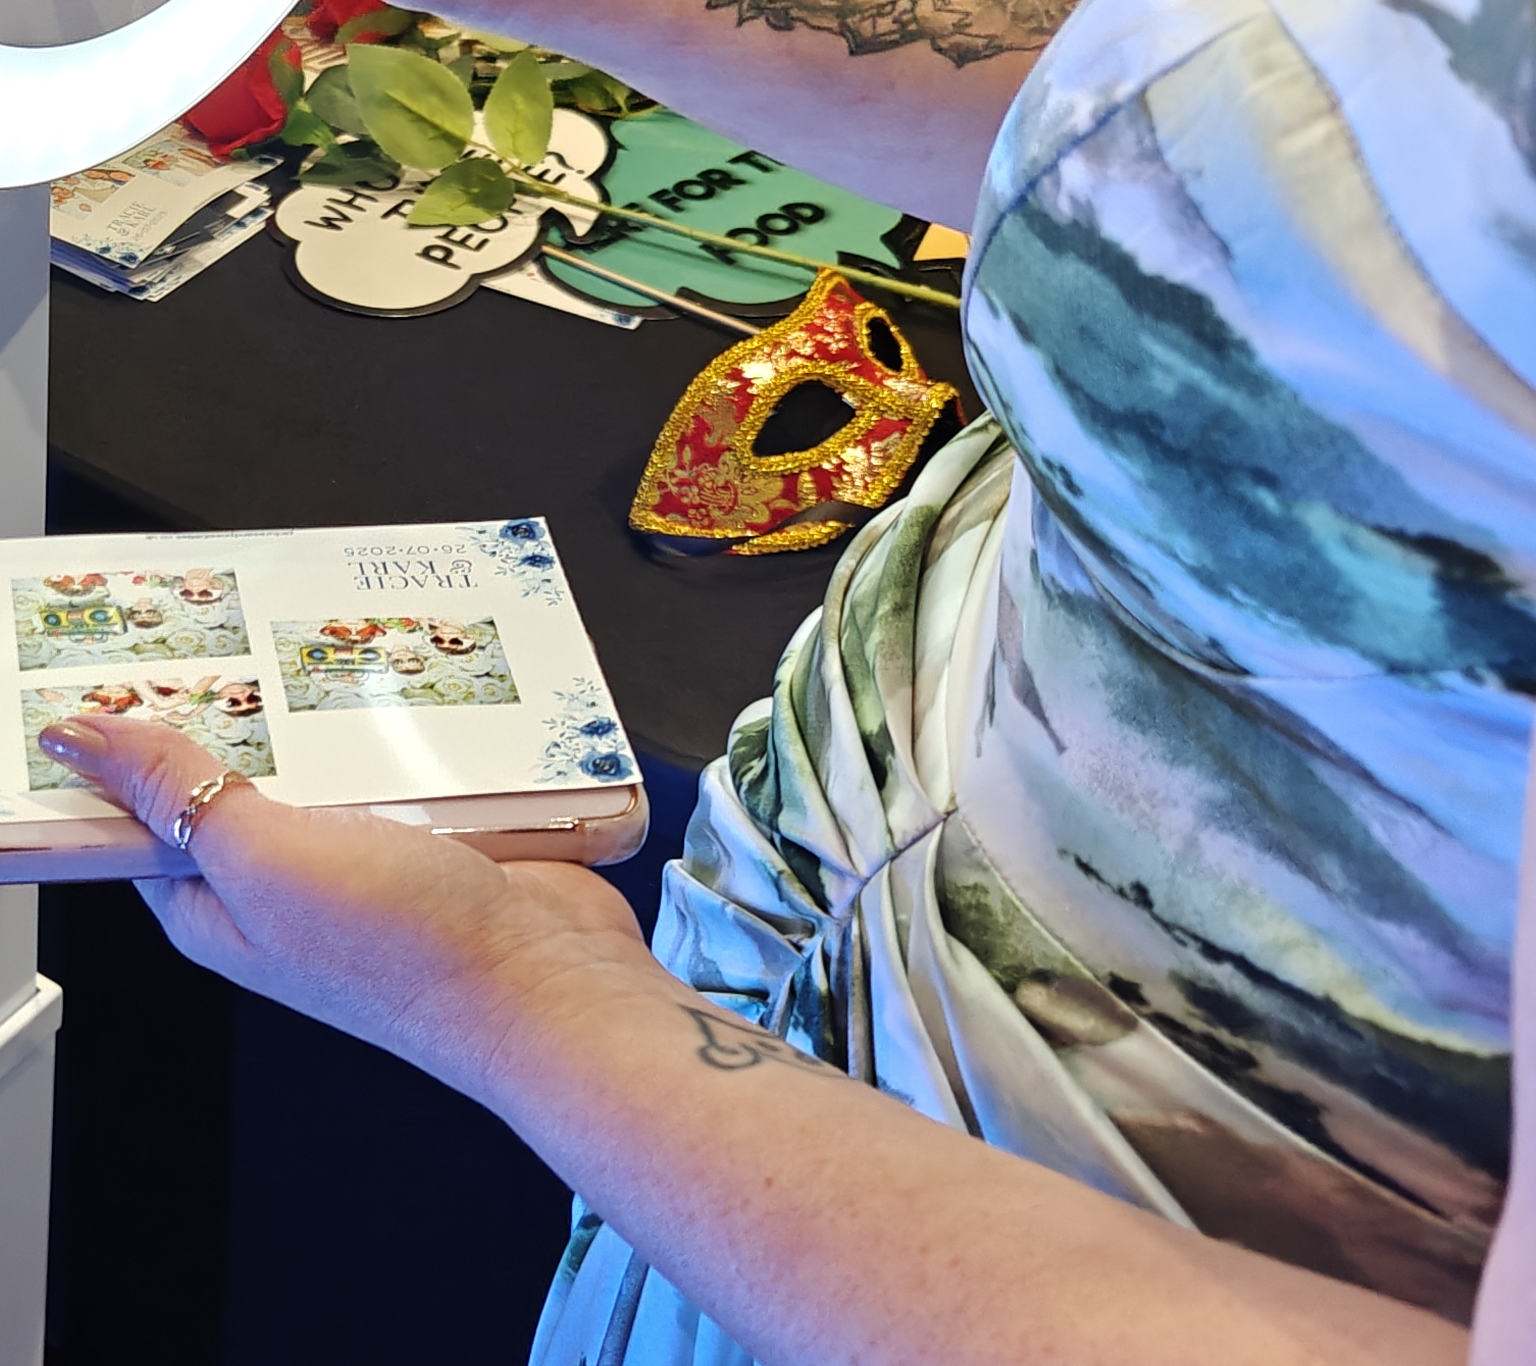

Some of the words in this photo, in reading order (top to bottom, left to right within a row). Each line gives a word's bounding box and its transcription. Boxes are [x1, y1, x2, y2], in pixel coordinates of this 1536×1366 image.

[647, 167, 748, 213] FOR
[347, 561, 436, 576] KARL
[449, 559, 473, 575] &
[353, 573, 478, 590] TRACIE
